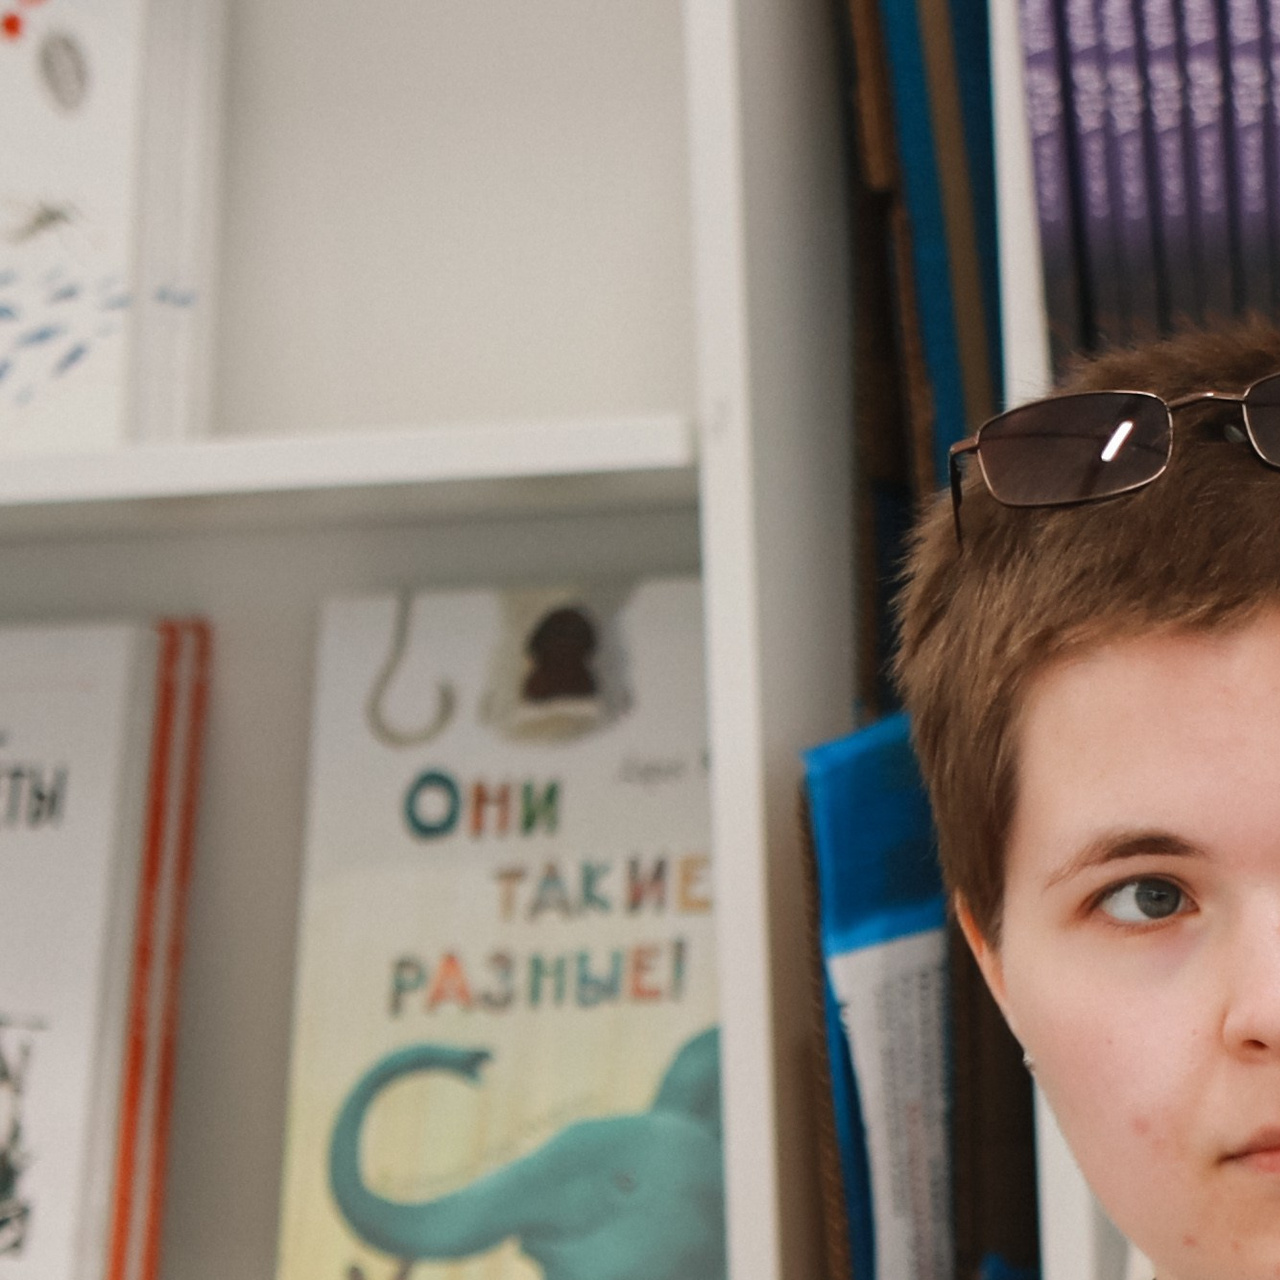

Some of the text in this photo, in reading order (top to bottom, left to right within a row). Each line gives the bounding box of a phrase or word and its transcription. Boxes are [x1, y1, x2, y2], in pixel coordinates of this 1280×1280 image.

[404, 769, 561, 842] ОНИ
[494, 853, 713, 923] ТАКИЕ
[388, 938, 688, 1018] РАЗНЫЕ!
